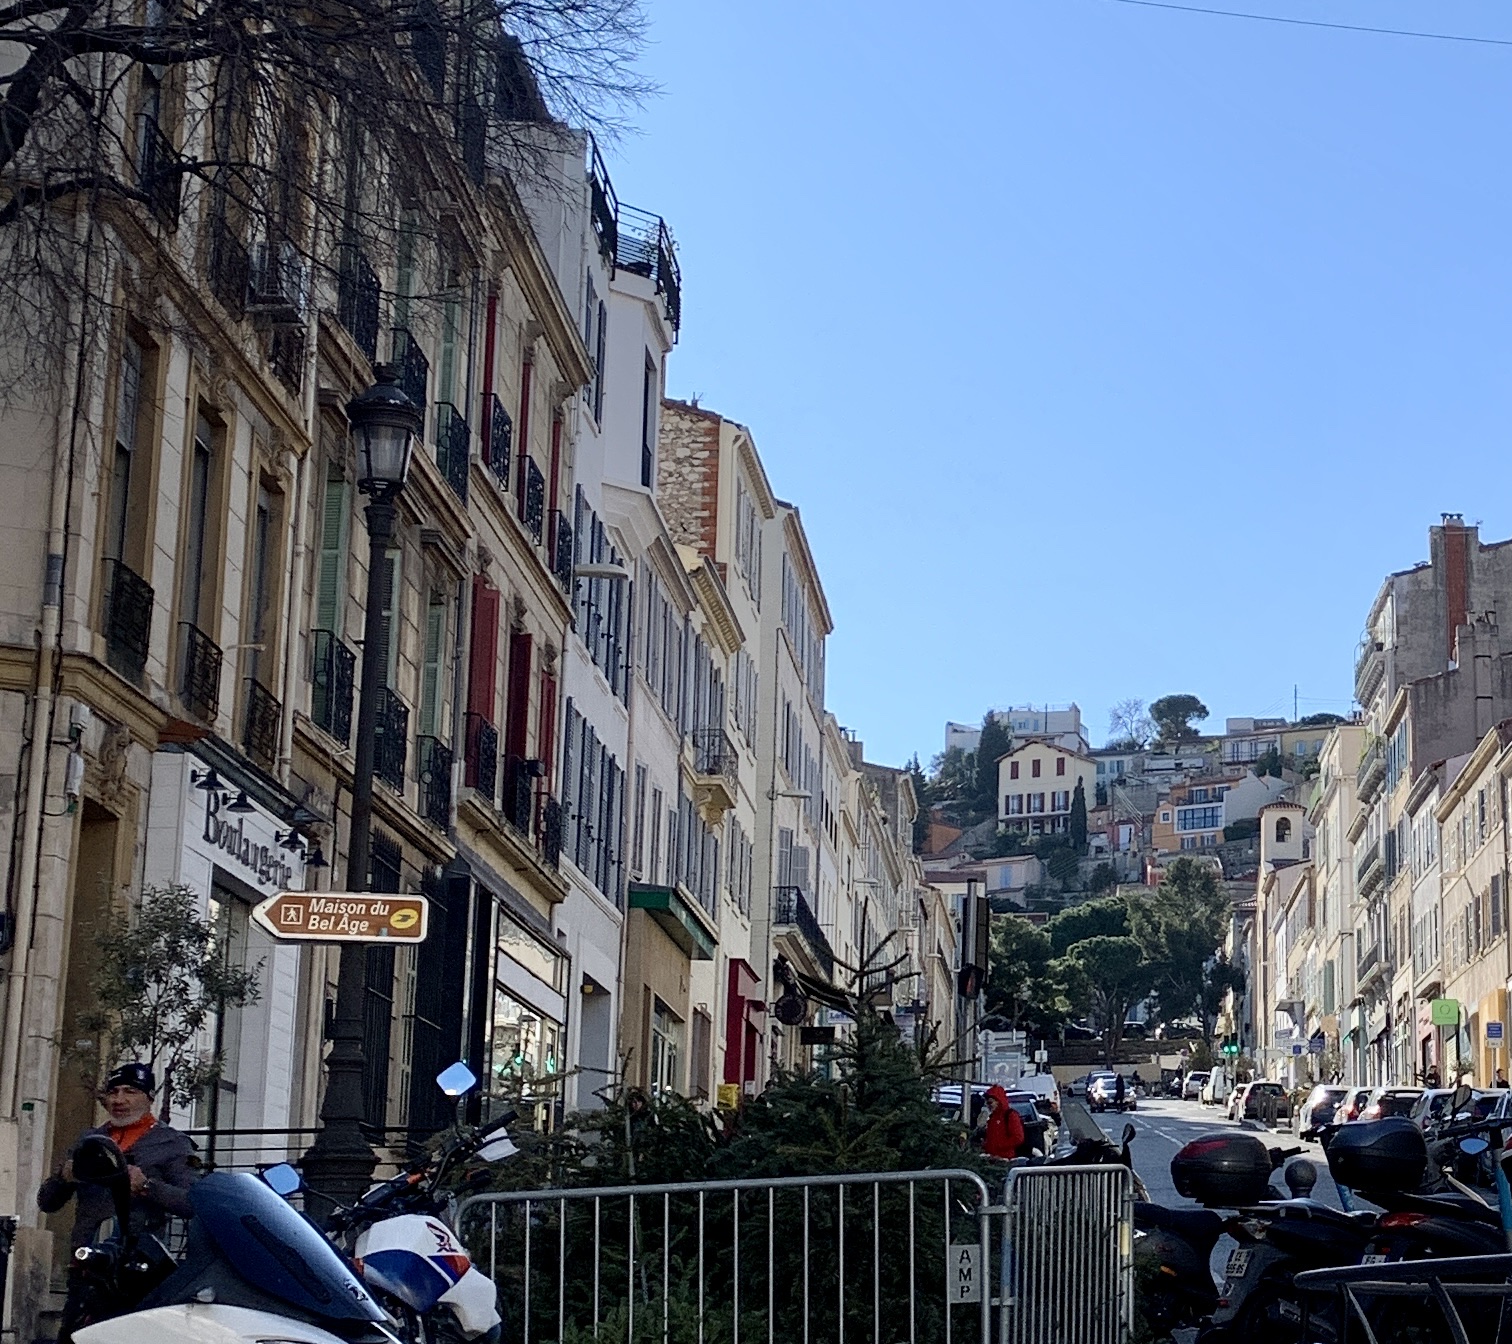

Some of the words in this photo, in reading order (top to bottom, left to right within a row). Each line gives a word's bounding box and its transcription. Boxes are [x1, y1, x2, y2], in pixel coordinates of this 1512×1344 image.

[202, 789, 293, 890] Boulangerie
[307, 914, 335, 931] Bel
[336, 913, 369, 935] Âge
[308, 898, 366, 915] Maison
[370, 900, 390, 916] du
[959, 1249, 972, 1299] AMP
